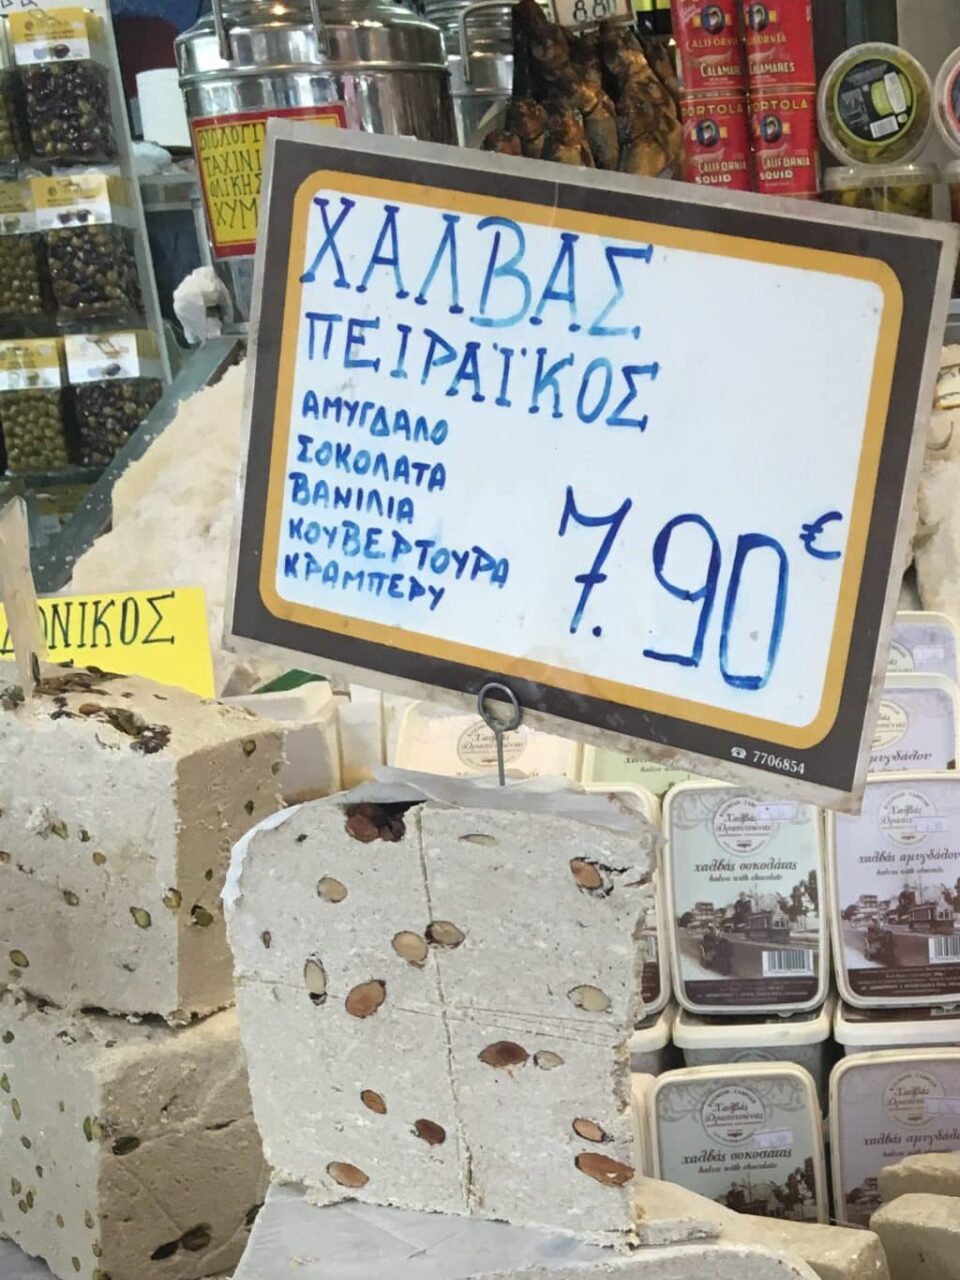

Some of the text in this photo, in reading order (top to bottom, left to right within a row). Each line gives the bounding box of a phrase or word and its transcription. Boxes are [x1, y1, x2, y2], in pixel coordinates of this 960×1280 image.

[759, 169, 794, 181] SQUID
[300, 197, 654, 339] ΧΑΛΒΑΣ
[305, 311, 660, 432] ΠΕΙΡΑΪΚΟΣ
[302, 389, 449, 445] ΑΜΥΓΔΑΛΟ
[297, 434, 447, 492] ΣΟΚΟΛΑΤΑ
[288, 471, 415, 524] ΒΑΝΙΛΙΑ
[284, 551, 446, 611] ΚΡΑΜΠΕΡΥ
[289, 516, 510, 589] ΚΟΥΒΕΡΤΟΥΡΑ
[752, 749, 806, 775] 7706854
